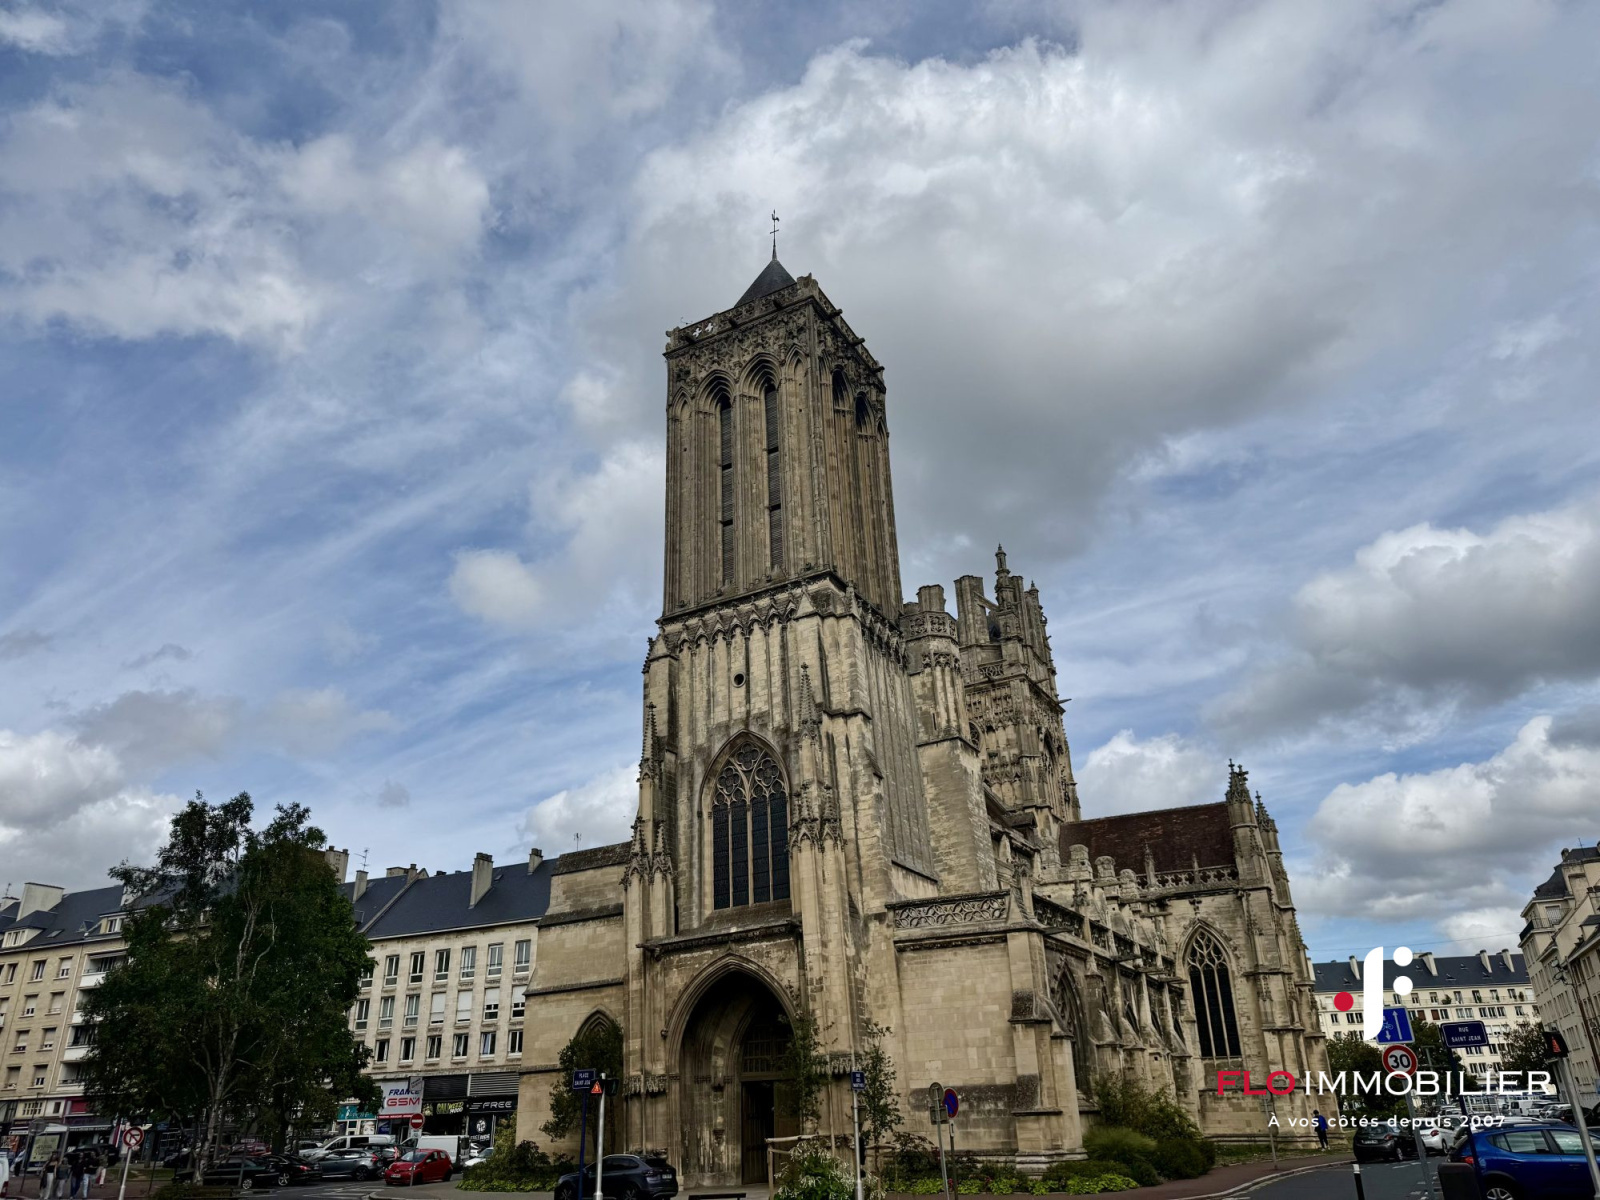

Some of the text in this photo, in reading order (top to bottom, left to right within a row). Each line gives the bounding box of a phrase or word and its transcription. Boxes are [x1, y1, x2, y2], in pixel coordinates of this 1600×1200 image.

[1389, 1054, 1411, 1068] 30
[387, 1097, 420, 1107] GSM
[482, 1101, 512, 1109] FREE
